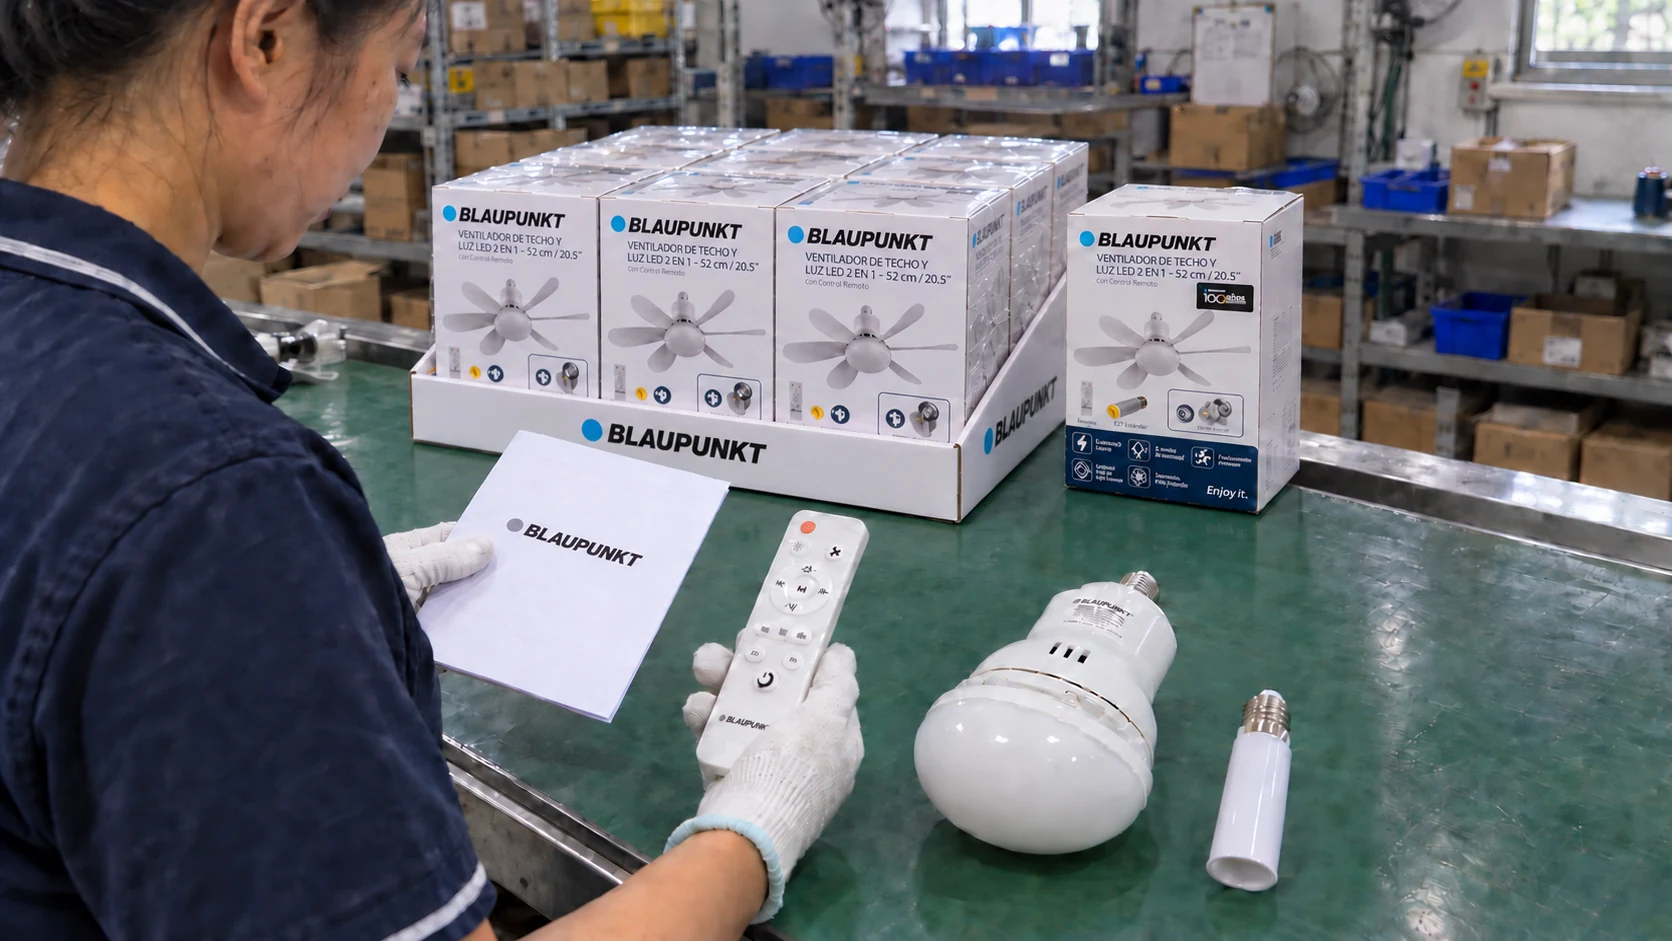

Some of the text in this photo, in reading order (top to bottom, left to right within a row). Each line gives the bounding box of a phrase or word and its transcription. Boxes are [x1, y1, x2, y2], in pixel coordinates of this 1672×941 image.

[459, 207, 565, 228] BLAUPUNKT
[628, 217, 742, 239] BLAUPUNKT
[458, 230, 510, 242] VENTILADOR
[513, 234, 523, 243] DE
[526, 235, 554, 245] TECHO
[807, 228, 933, 250] BLAUPUNKT
[1098, 232, 1216, 251] BLAUPUNKT
[459, 242, 474, 250] LUZ
[476, 243, 492, 252] LED
[494, 244, 498, 253] 2
[501, 245, 512, 253] EN
[527, 247, 537, 256] 52
[628, 241, 737, 257] VENTILADOR DE TECHO Y
[628, 253, 644, 263] LUZ
[647, 254, 662, 264] LED
[666, 256, 670, 265] 2
[673, 256, 684, 266] EN
[687, 258, 691, 266] 1
[700, 259, 711, 269] 52
[714, 262, 728, 270] cm
[806, 252, 928, 269] VENTILADOR DE TECHO Y
[1097, 254, 1217, 268] VENTILADOR DE TECHO Y
[806, 265, 824, 275] LUZ
[826, 267, 844, 277] LED
[847, 268, 852, 277] 2
[855, 269, 868, 278] EN
[871, 270, 875, 279] 1
[886, 272, 898, 281] 52
[901, 274, 916, 282] cm
[1097, 265, 1114, 275] LUZ
[1117, 267, 1135, 276] LED
[1137, 268, 1142, 276] 2
[1146, 268, 1158, 277] EN
[1161, 269, 1165, 277] 1
[1176, 269, 1187, 278] 52
[818, 279, 842, 288] Control
[843, 281, 869, 290] Remoto
[1203, 292, 1226, 304] 100
[995, 376, 1057, 448] BLAUPUNKT
[607, 423, 767, 464] BLAUPUNKT
[1206, 485, 1248, 500] Enjoy it.
[524, 524, 643, 567] BLAUPUNKT
